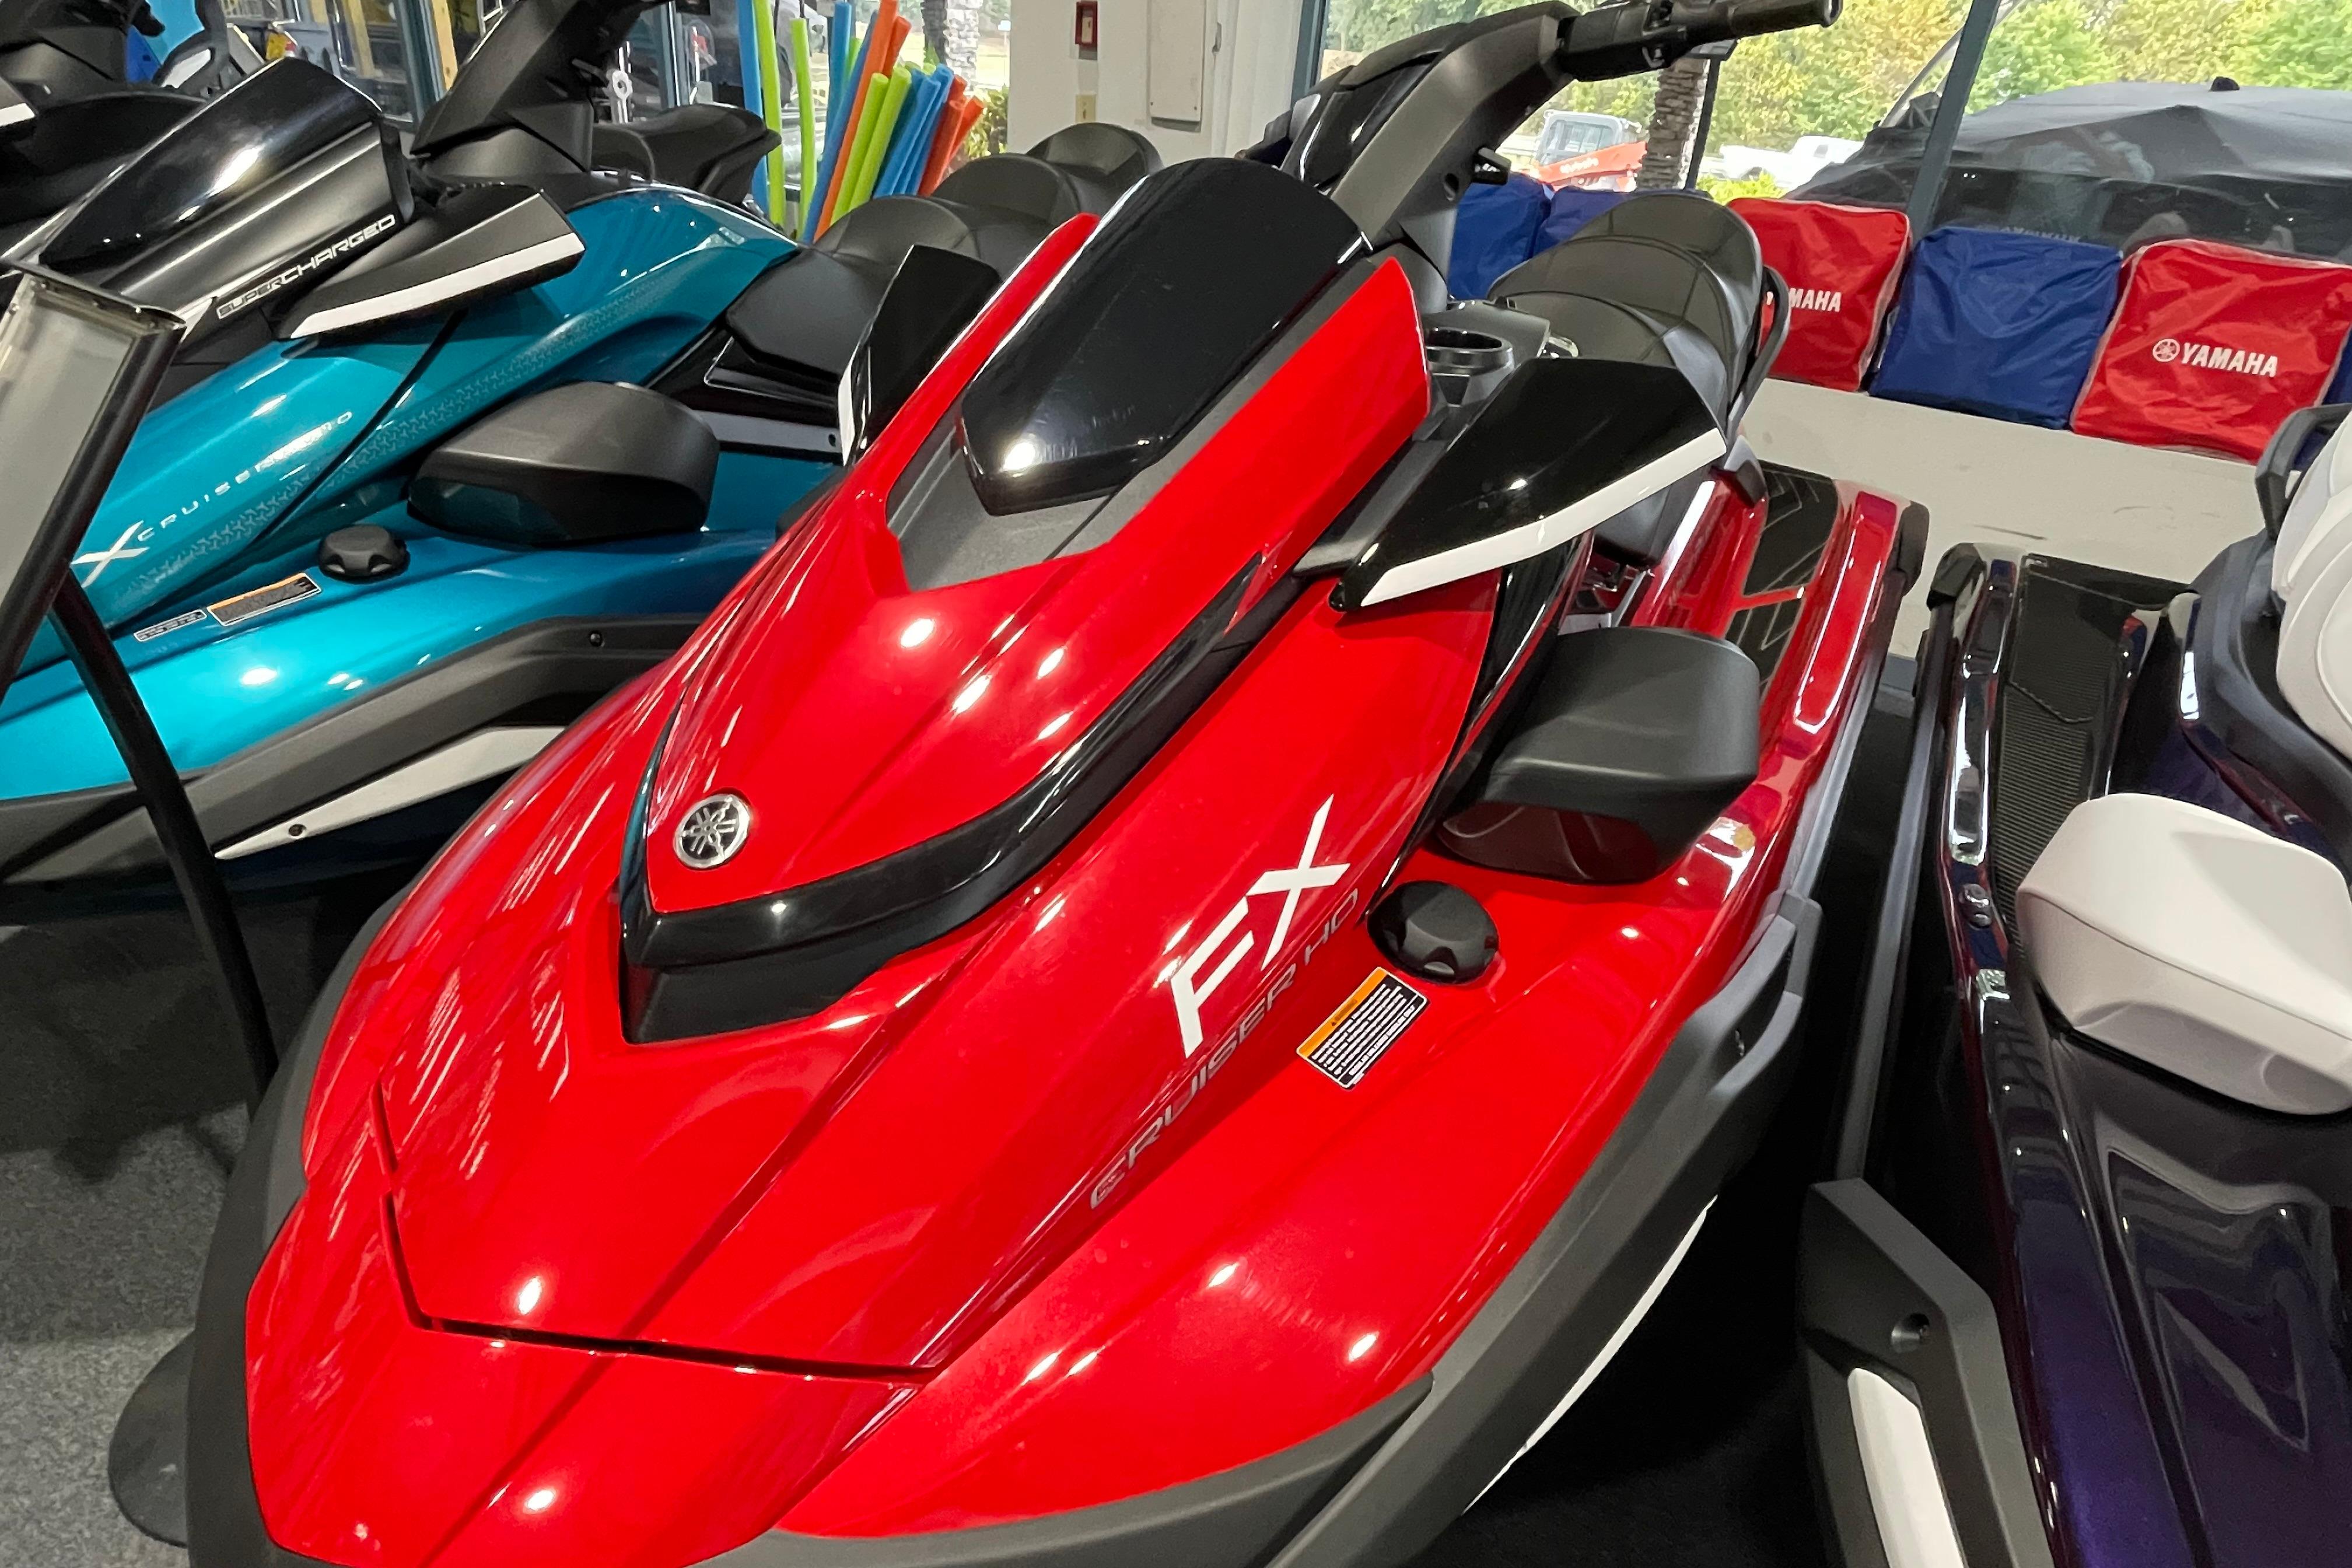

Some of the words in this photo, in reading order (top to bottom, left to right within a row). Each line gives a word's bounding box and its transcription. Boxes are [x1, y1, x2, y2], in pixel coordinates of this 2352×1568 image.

[216, 214, 396, 320] SUPERCHARGED
[1767, 287, 1842, 313] MAHA
[2182, 342, 2278, 378] YAMAHA
[70, 520, 150, 589] X
[1170, 793, 1351, 1059] FX
[1090, 963, 1296, 1209] CRUISER
[1304, 888, 1359, 966] HO
